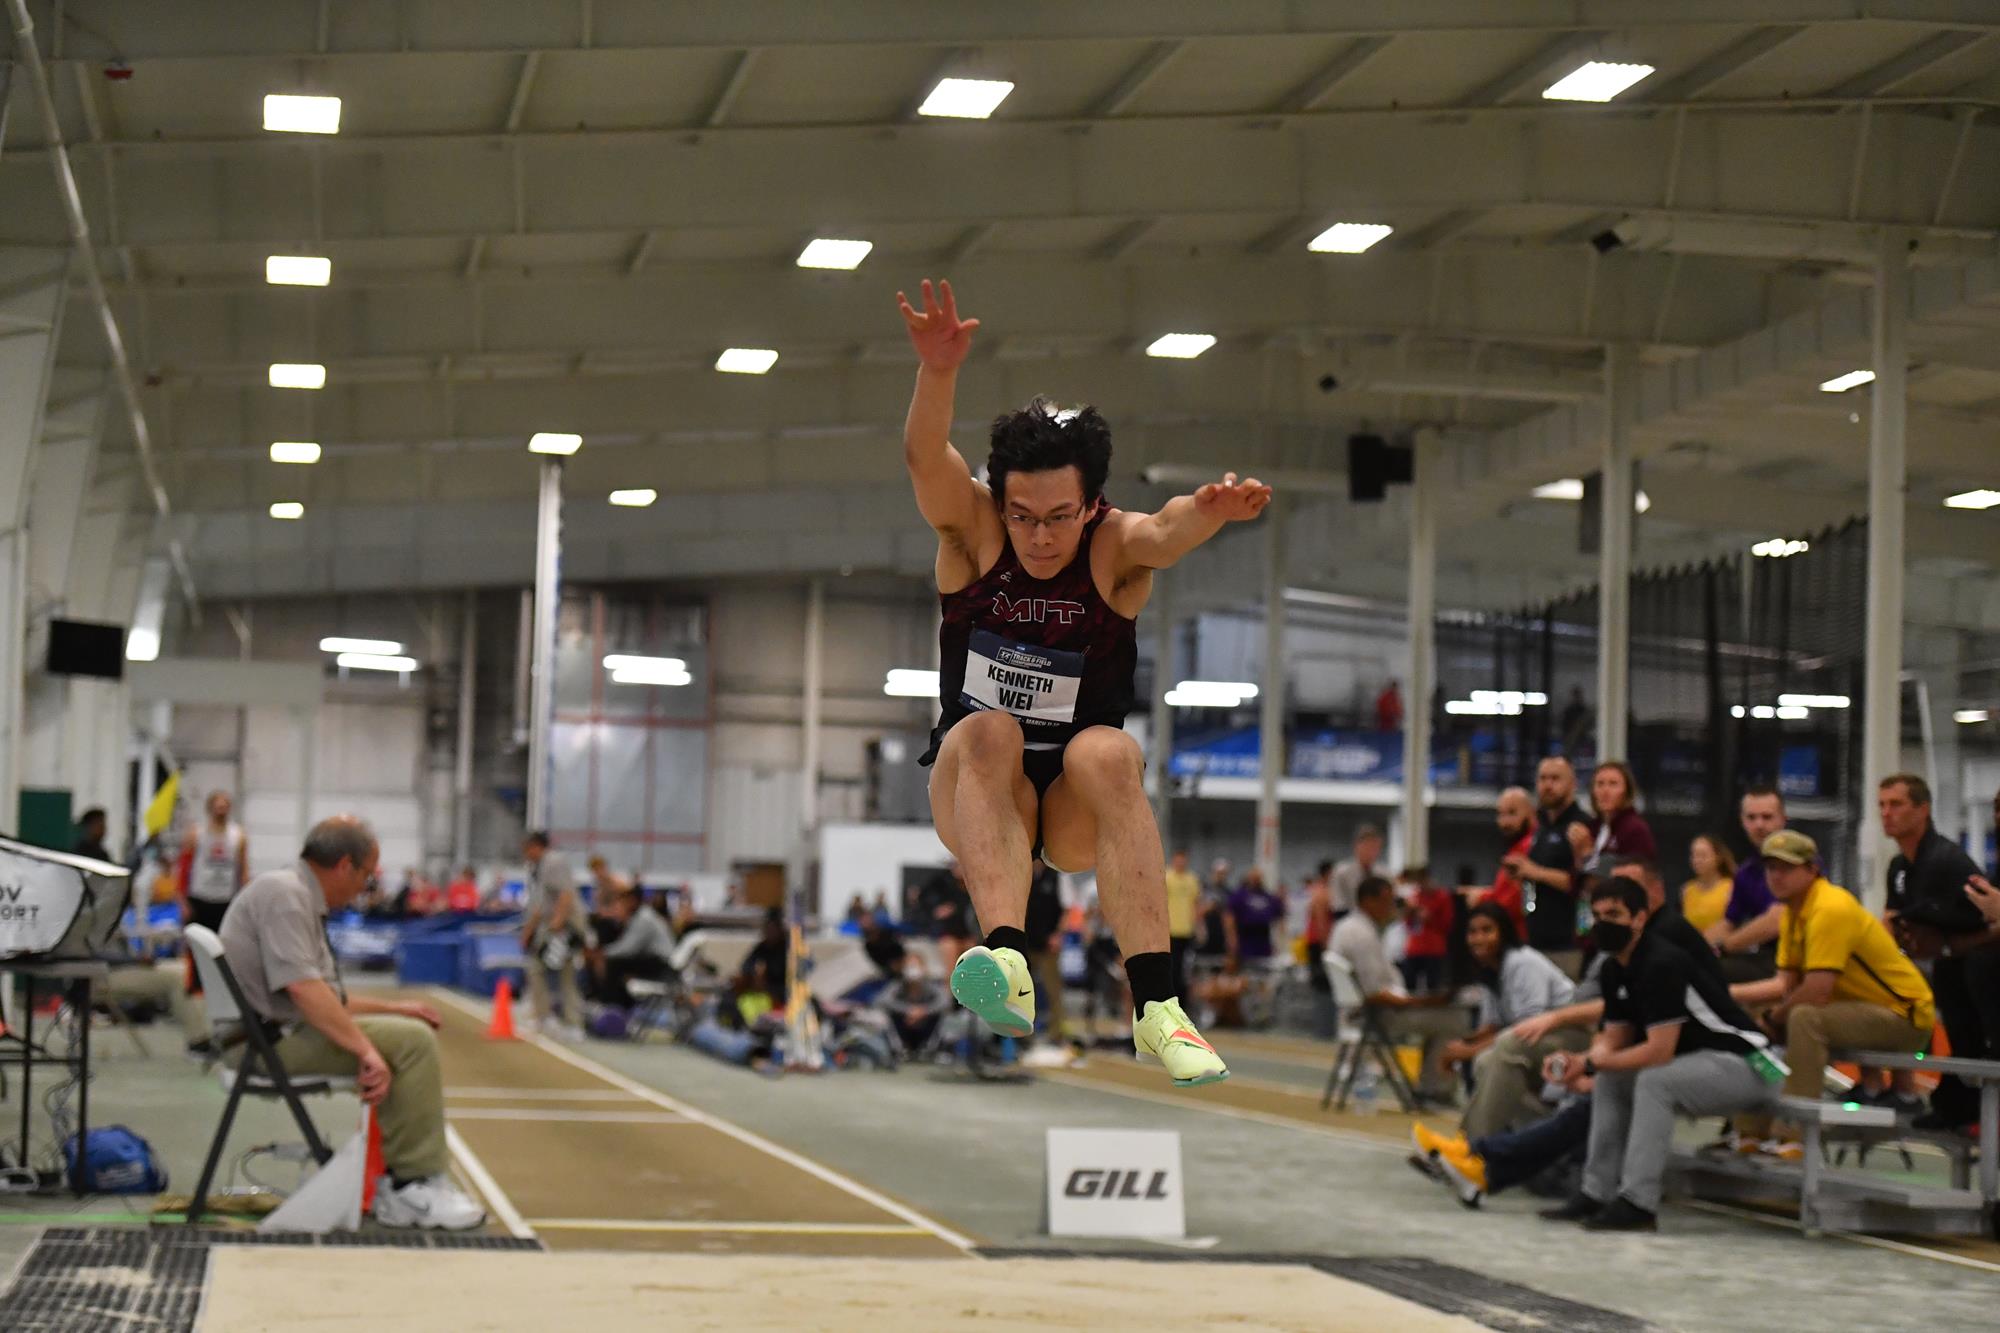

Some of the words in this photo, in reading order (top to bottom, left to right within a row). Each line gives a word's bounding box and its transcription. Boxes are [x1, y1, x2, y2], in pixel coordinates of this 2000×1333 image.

[992, 591, 1086, 624] MIT
[1012, 653, 1032, 662] TRACK
[1036, 658, 1052, 667] FIELD
[987, 664, 1054, 694] KENNETH
[999, 687, 1034, 711] WEI
[1063, 1169, 1169, 1200] GILL
